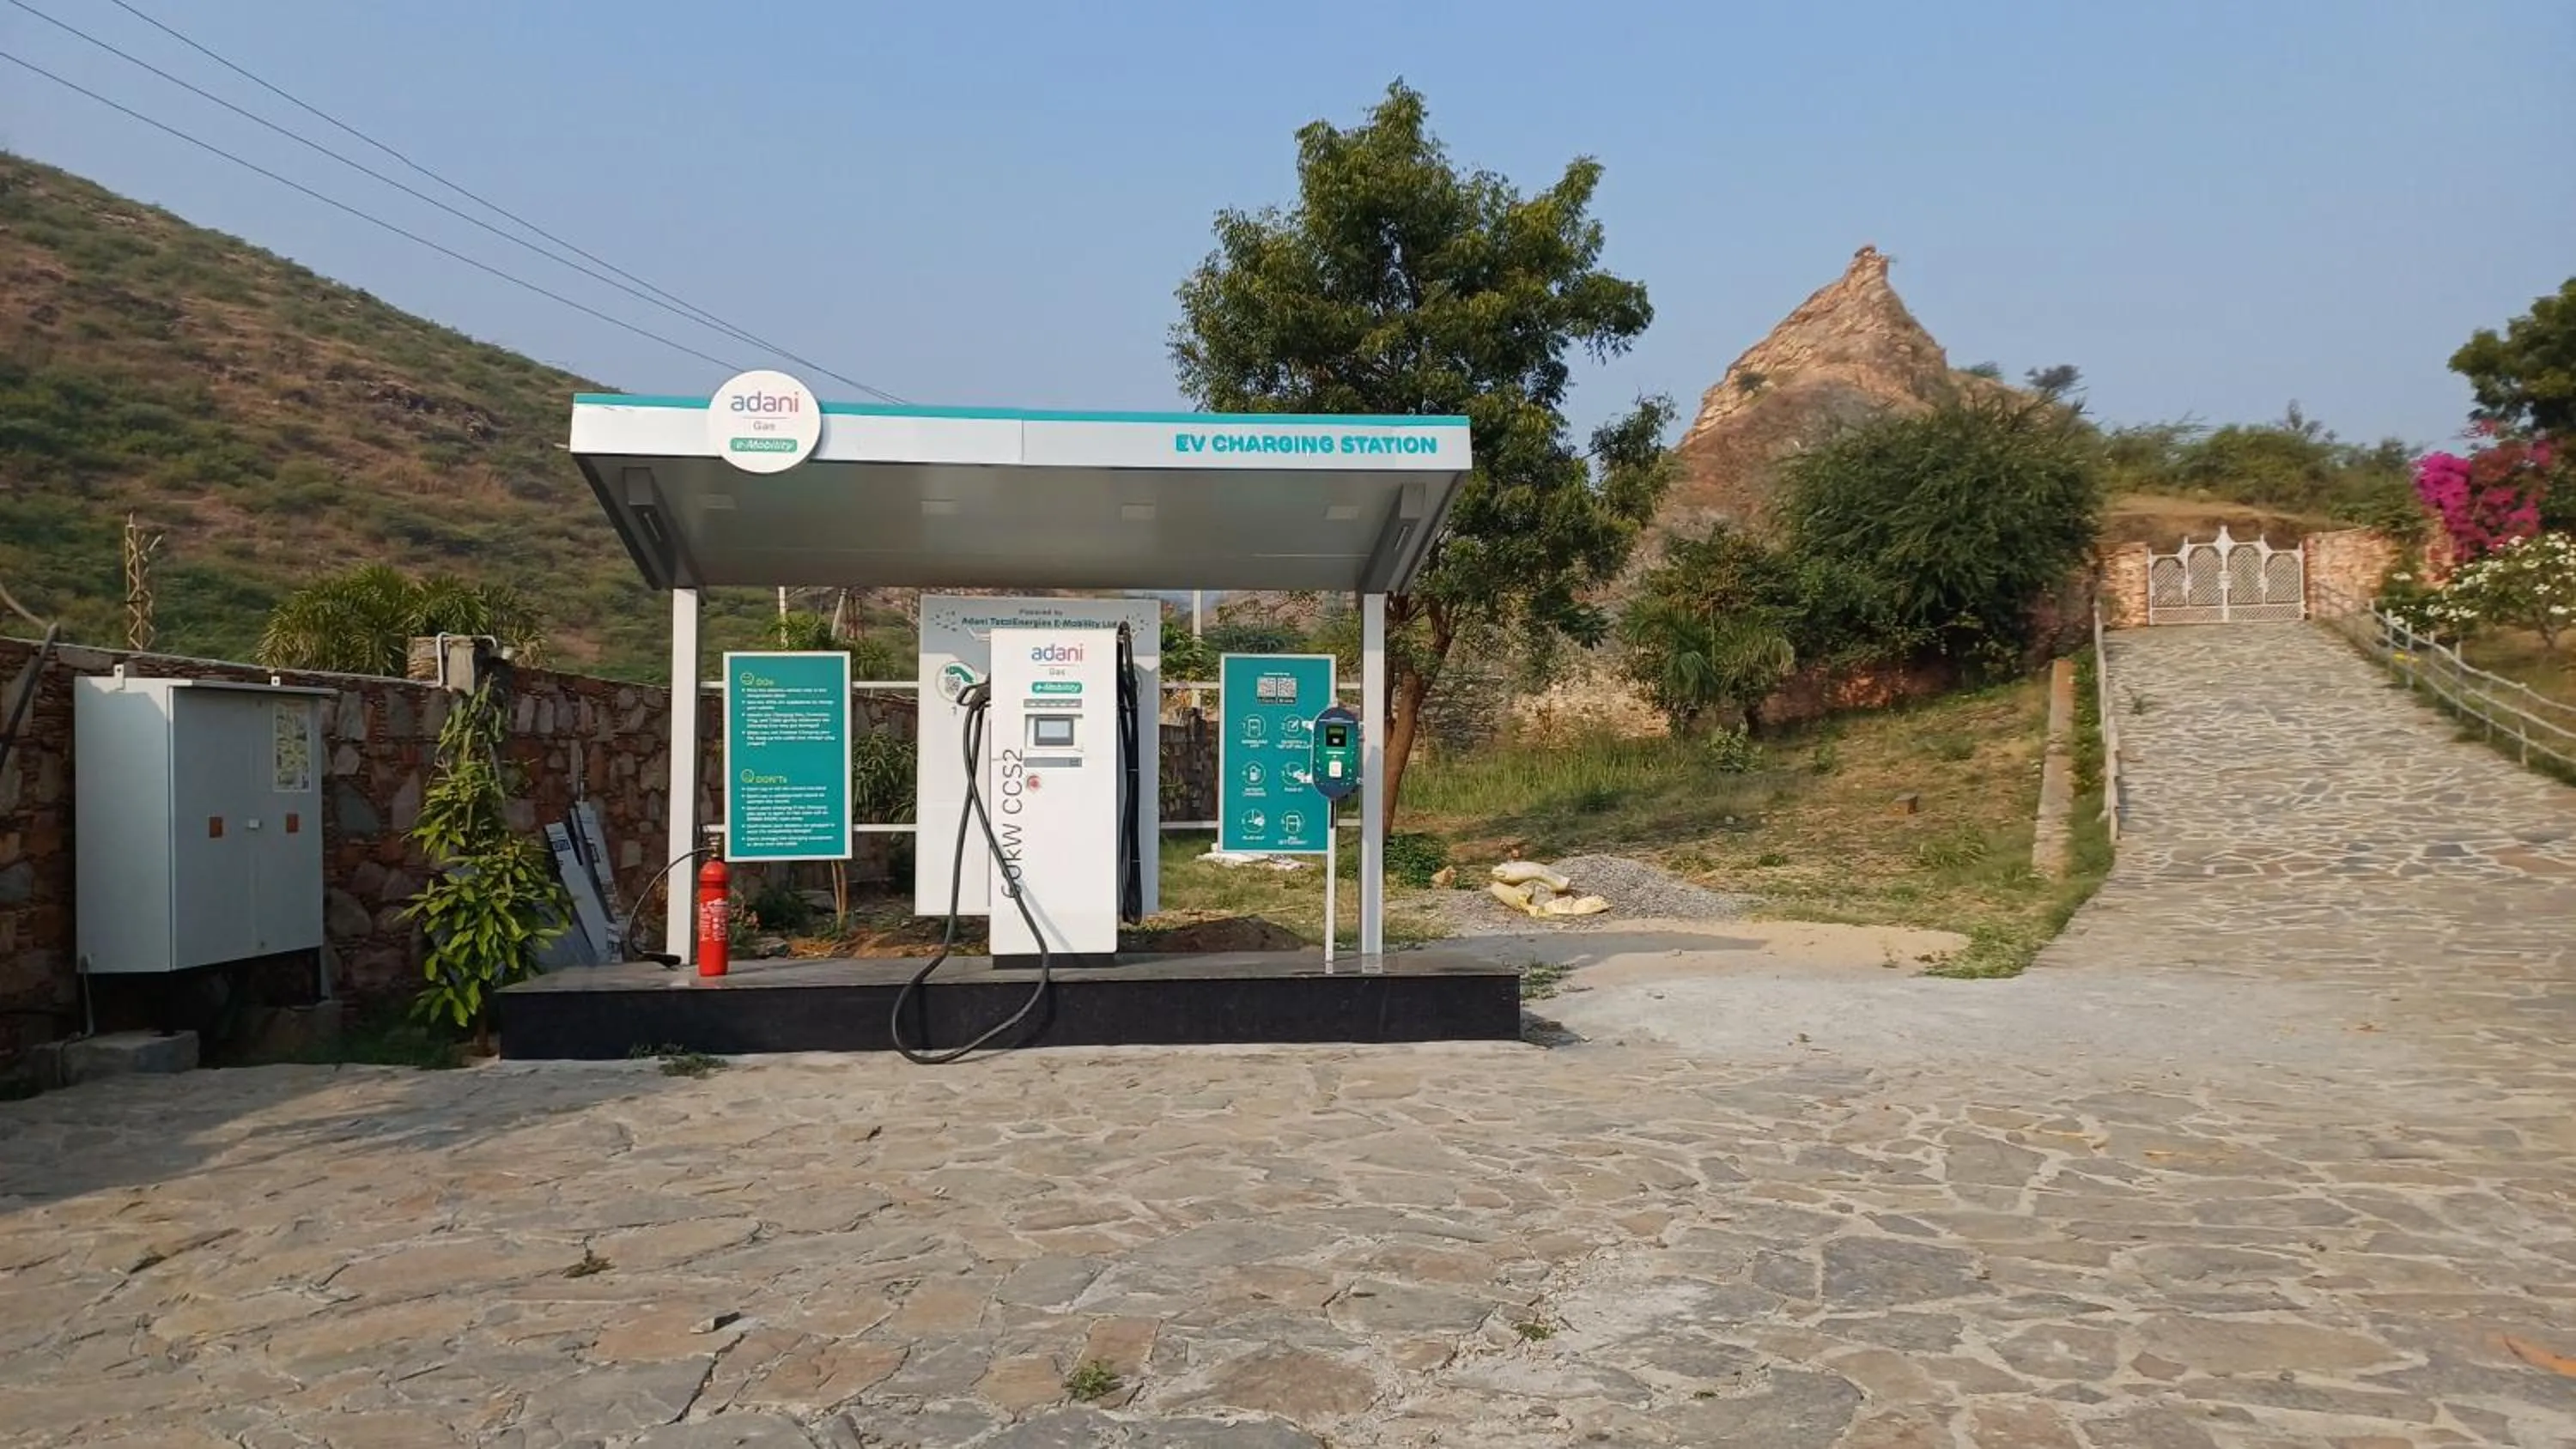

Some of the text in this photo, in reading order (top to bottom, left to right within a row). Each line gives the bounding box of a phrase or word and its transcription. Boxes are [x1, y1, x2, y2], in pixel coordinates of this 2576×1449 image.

[731, 391, 799, 413] adani
[753, 421, 776, 431] Gas
[1176, 433, 1437, 454] EV CHARGING STATION
[962, 617, 988, 626] Adani
[1031, 643, 1084, 662] adani
[1002, 748, 1023, 815] CCS2
